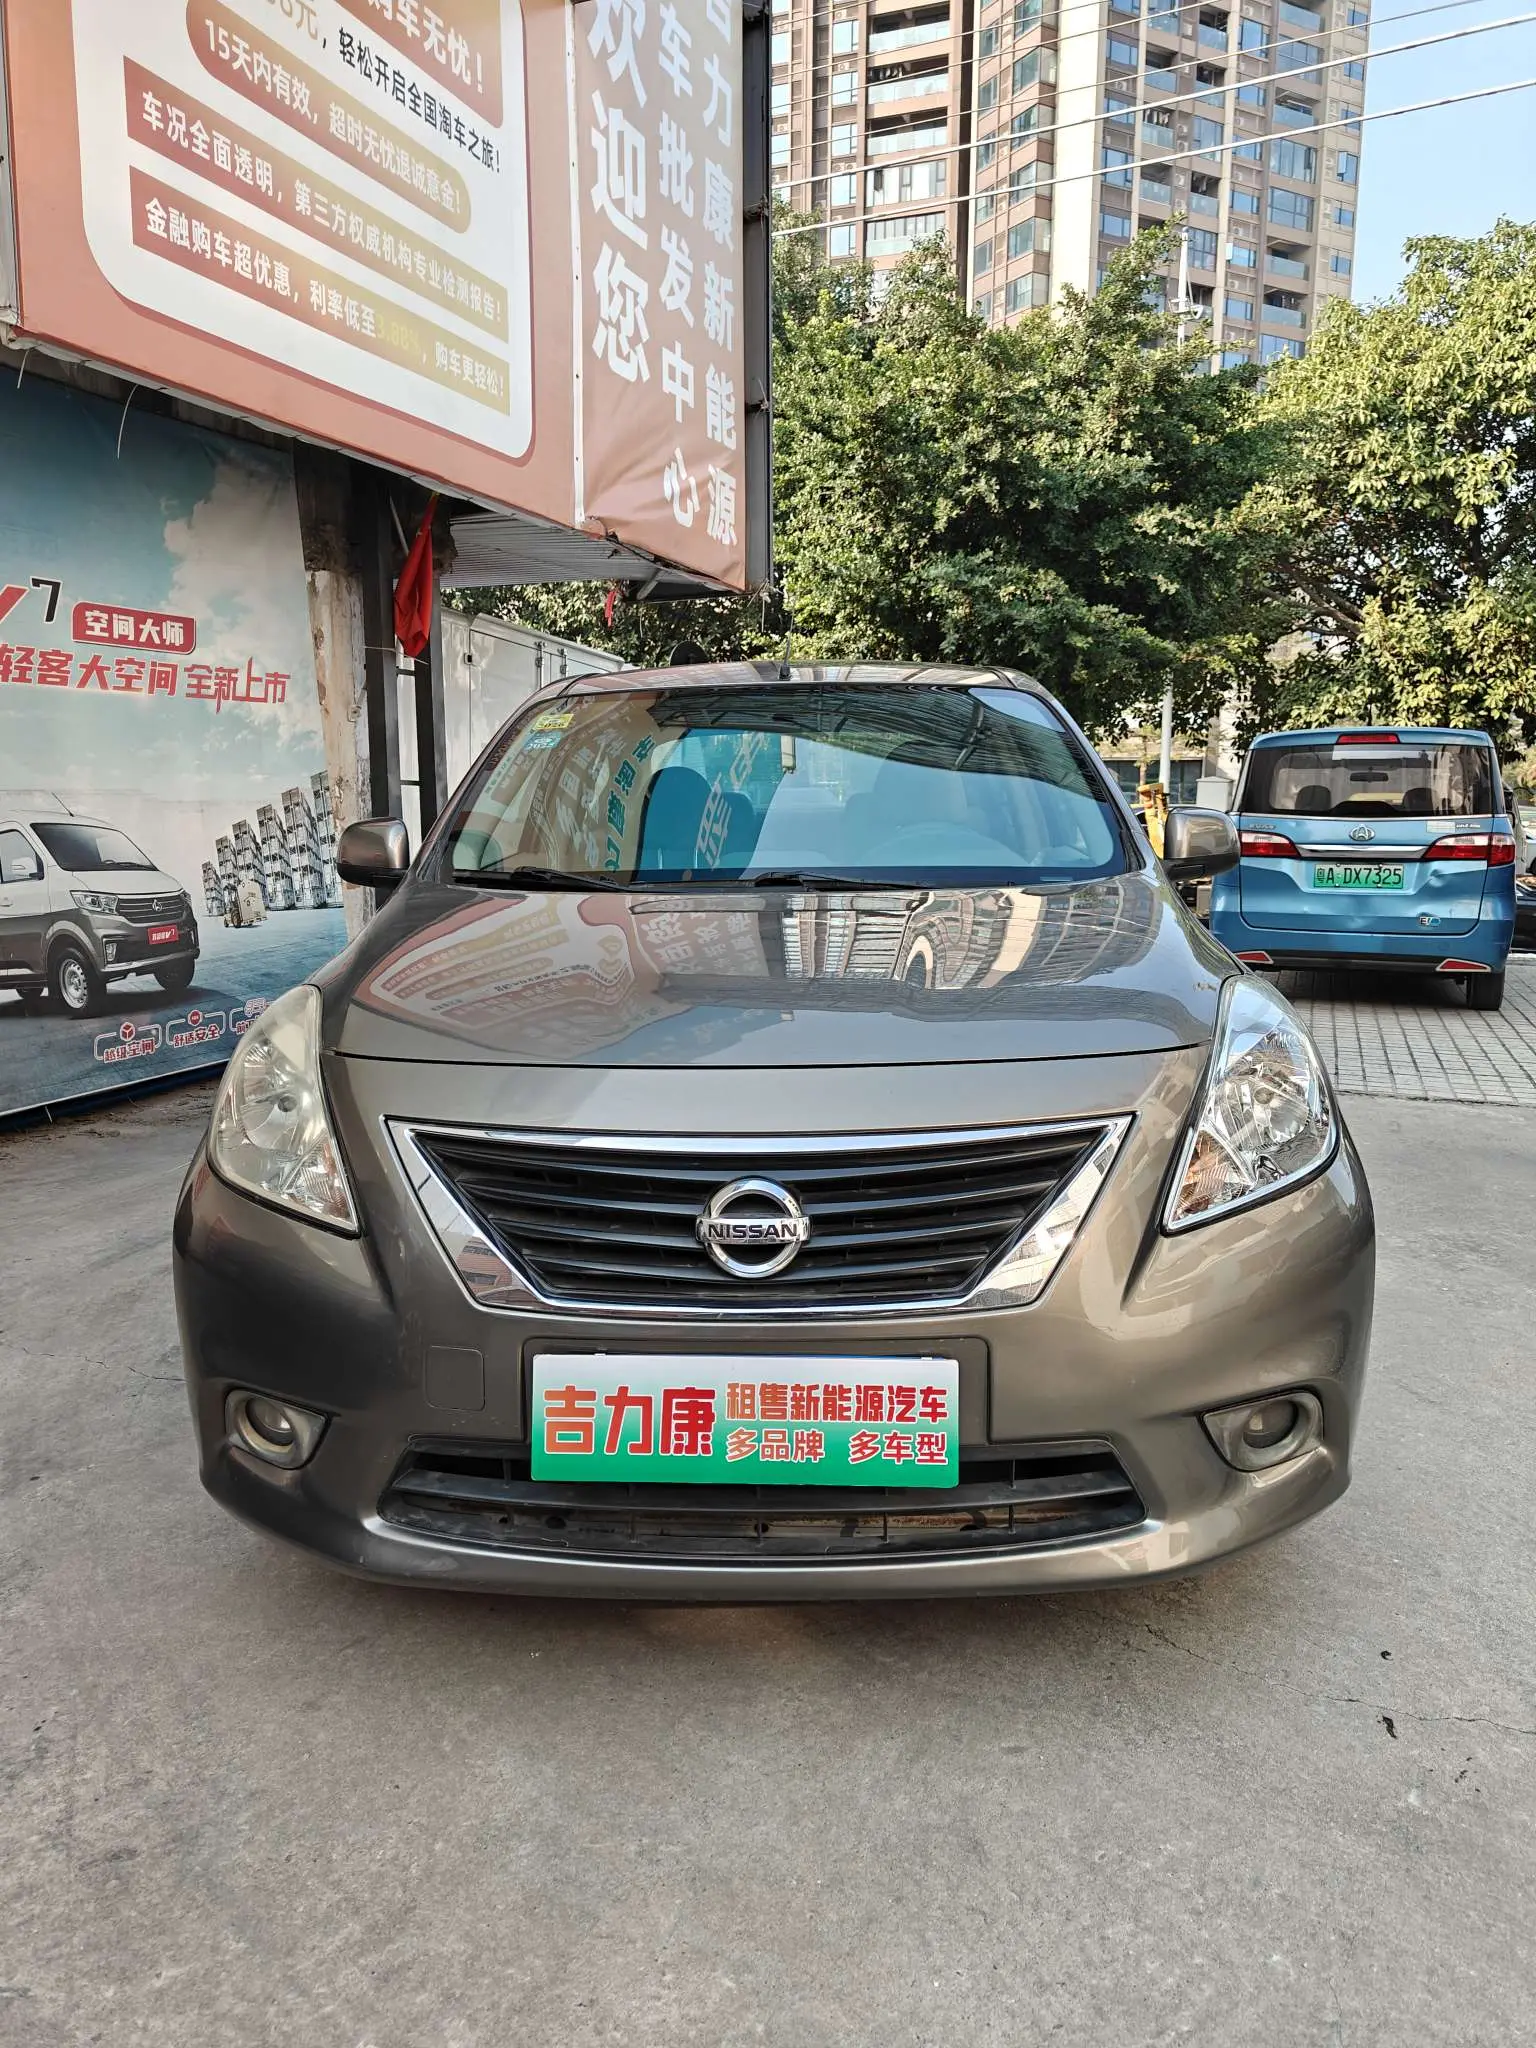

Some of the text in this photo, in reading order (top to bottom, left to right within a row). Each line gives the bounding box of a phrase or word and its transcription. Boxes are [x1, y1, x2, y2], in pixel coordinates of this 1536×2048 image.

[85, 610, 184, 646] 空间大师
[173, 1024, 220, 1048] 舒适安全
[708, 1223, 798, 1239] NISSAN
[543, 1385, 716, 1455] 吉力康
[726, 1382, 949, 1424] 租售新能源汽车
[726, 1428, 949, 1466] 多品牌 多车型
